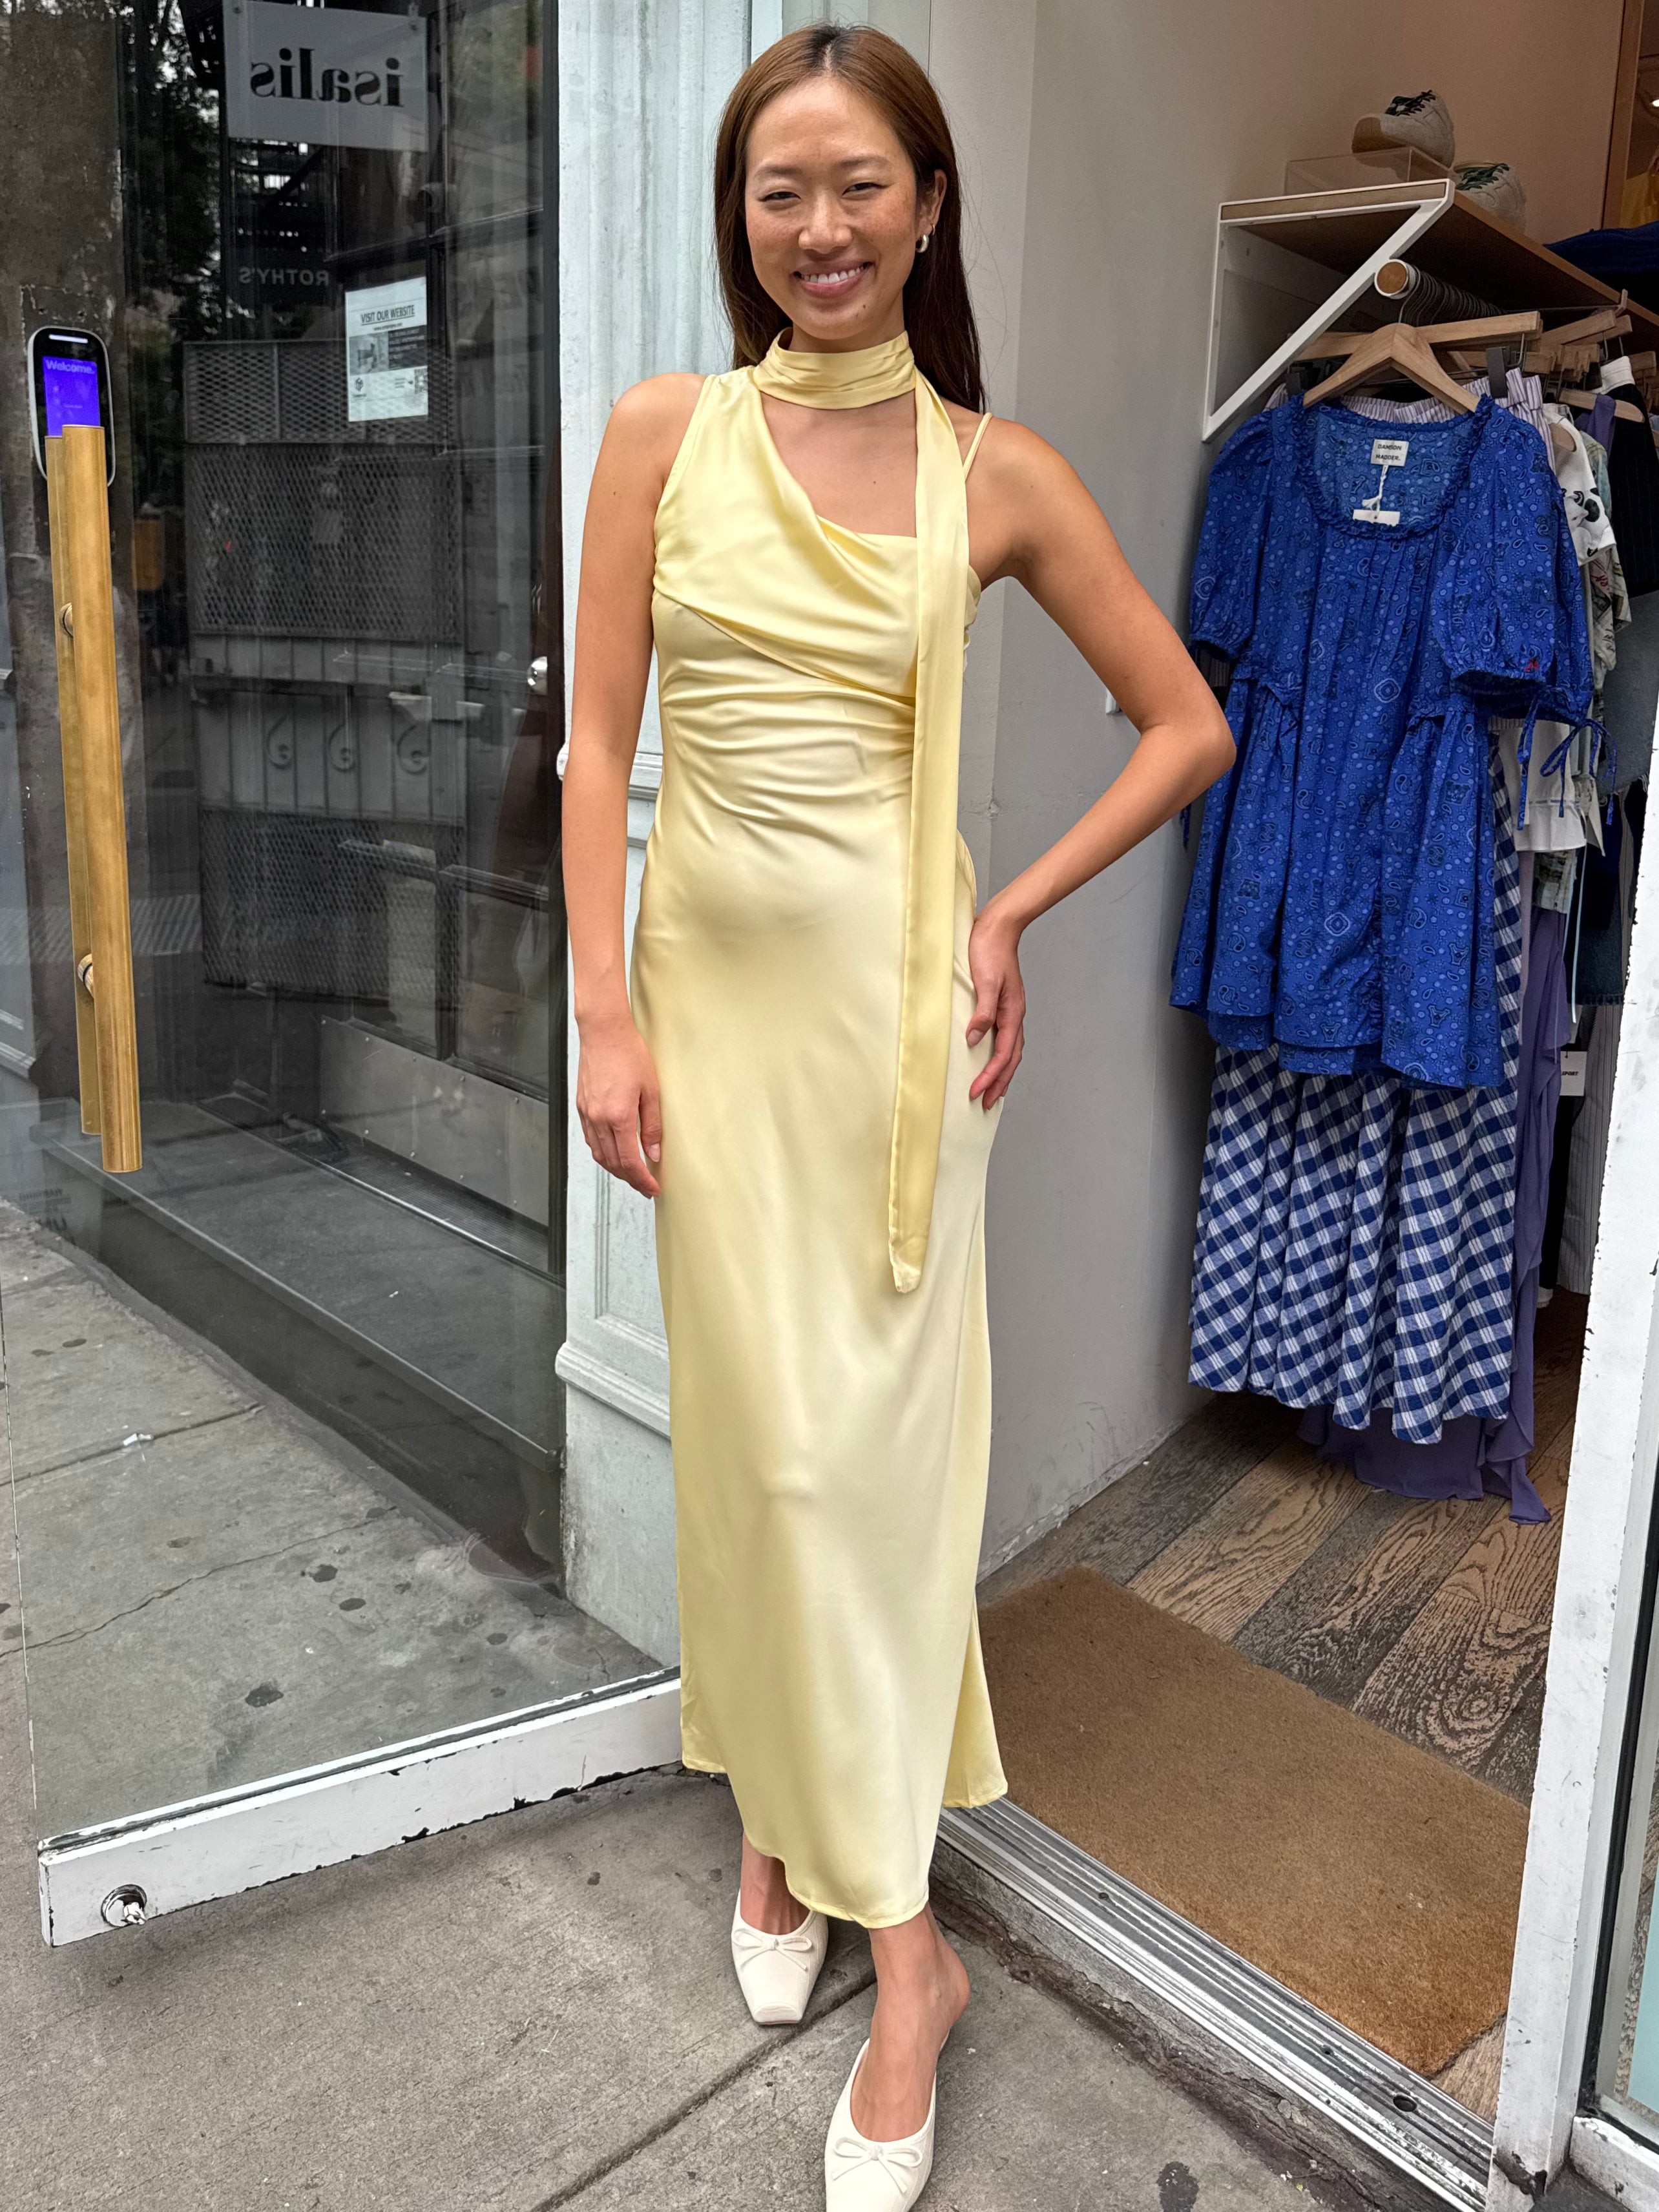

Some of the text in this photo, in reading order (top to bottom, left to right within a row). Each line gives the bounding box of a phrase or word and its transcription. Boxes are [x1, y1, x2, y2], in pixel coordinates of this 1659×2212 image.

[360, 304, 415, 323] VISIT OUR WEBSITE
